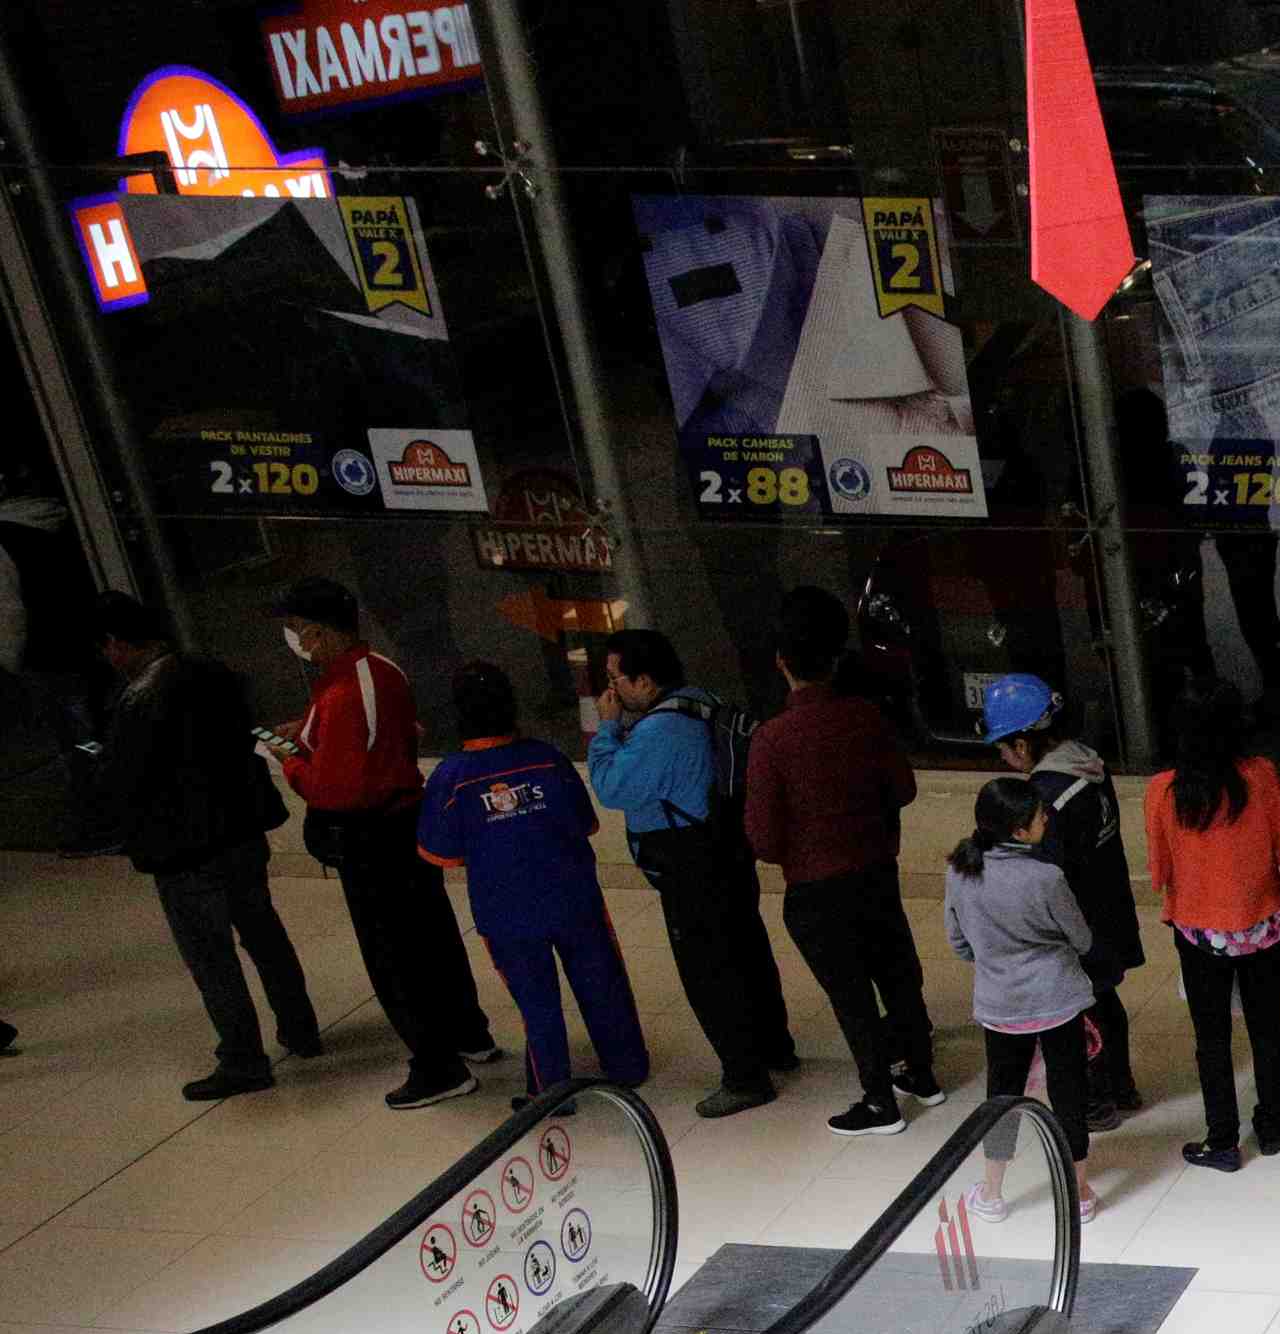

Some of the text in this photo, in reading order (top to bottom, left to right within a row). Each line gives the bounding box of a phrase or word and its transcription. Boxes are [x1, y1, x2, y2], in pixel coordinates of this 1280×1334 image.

[352, 204, 400, 224] PAPÁ
[874, 206, 924, 226] PAPÁ
[371, 241, 404, 287] 2
[889, 242, 921, 288] 2
[707, 436, 736, 449] PACK
[1181, 454, 1216, 466] PACK
[1219, 455, 1263, 467] JEANS
[392, 464, 468, 483] HIPERMAXI
[891, 473, 969, 490] HIPERMAXI
